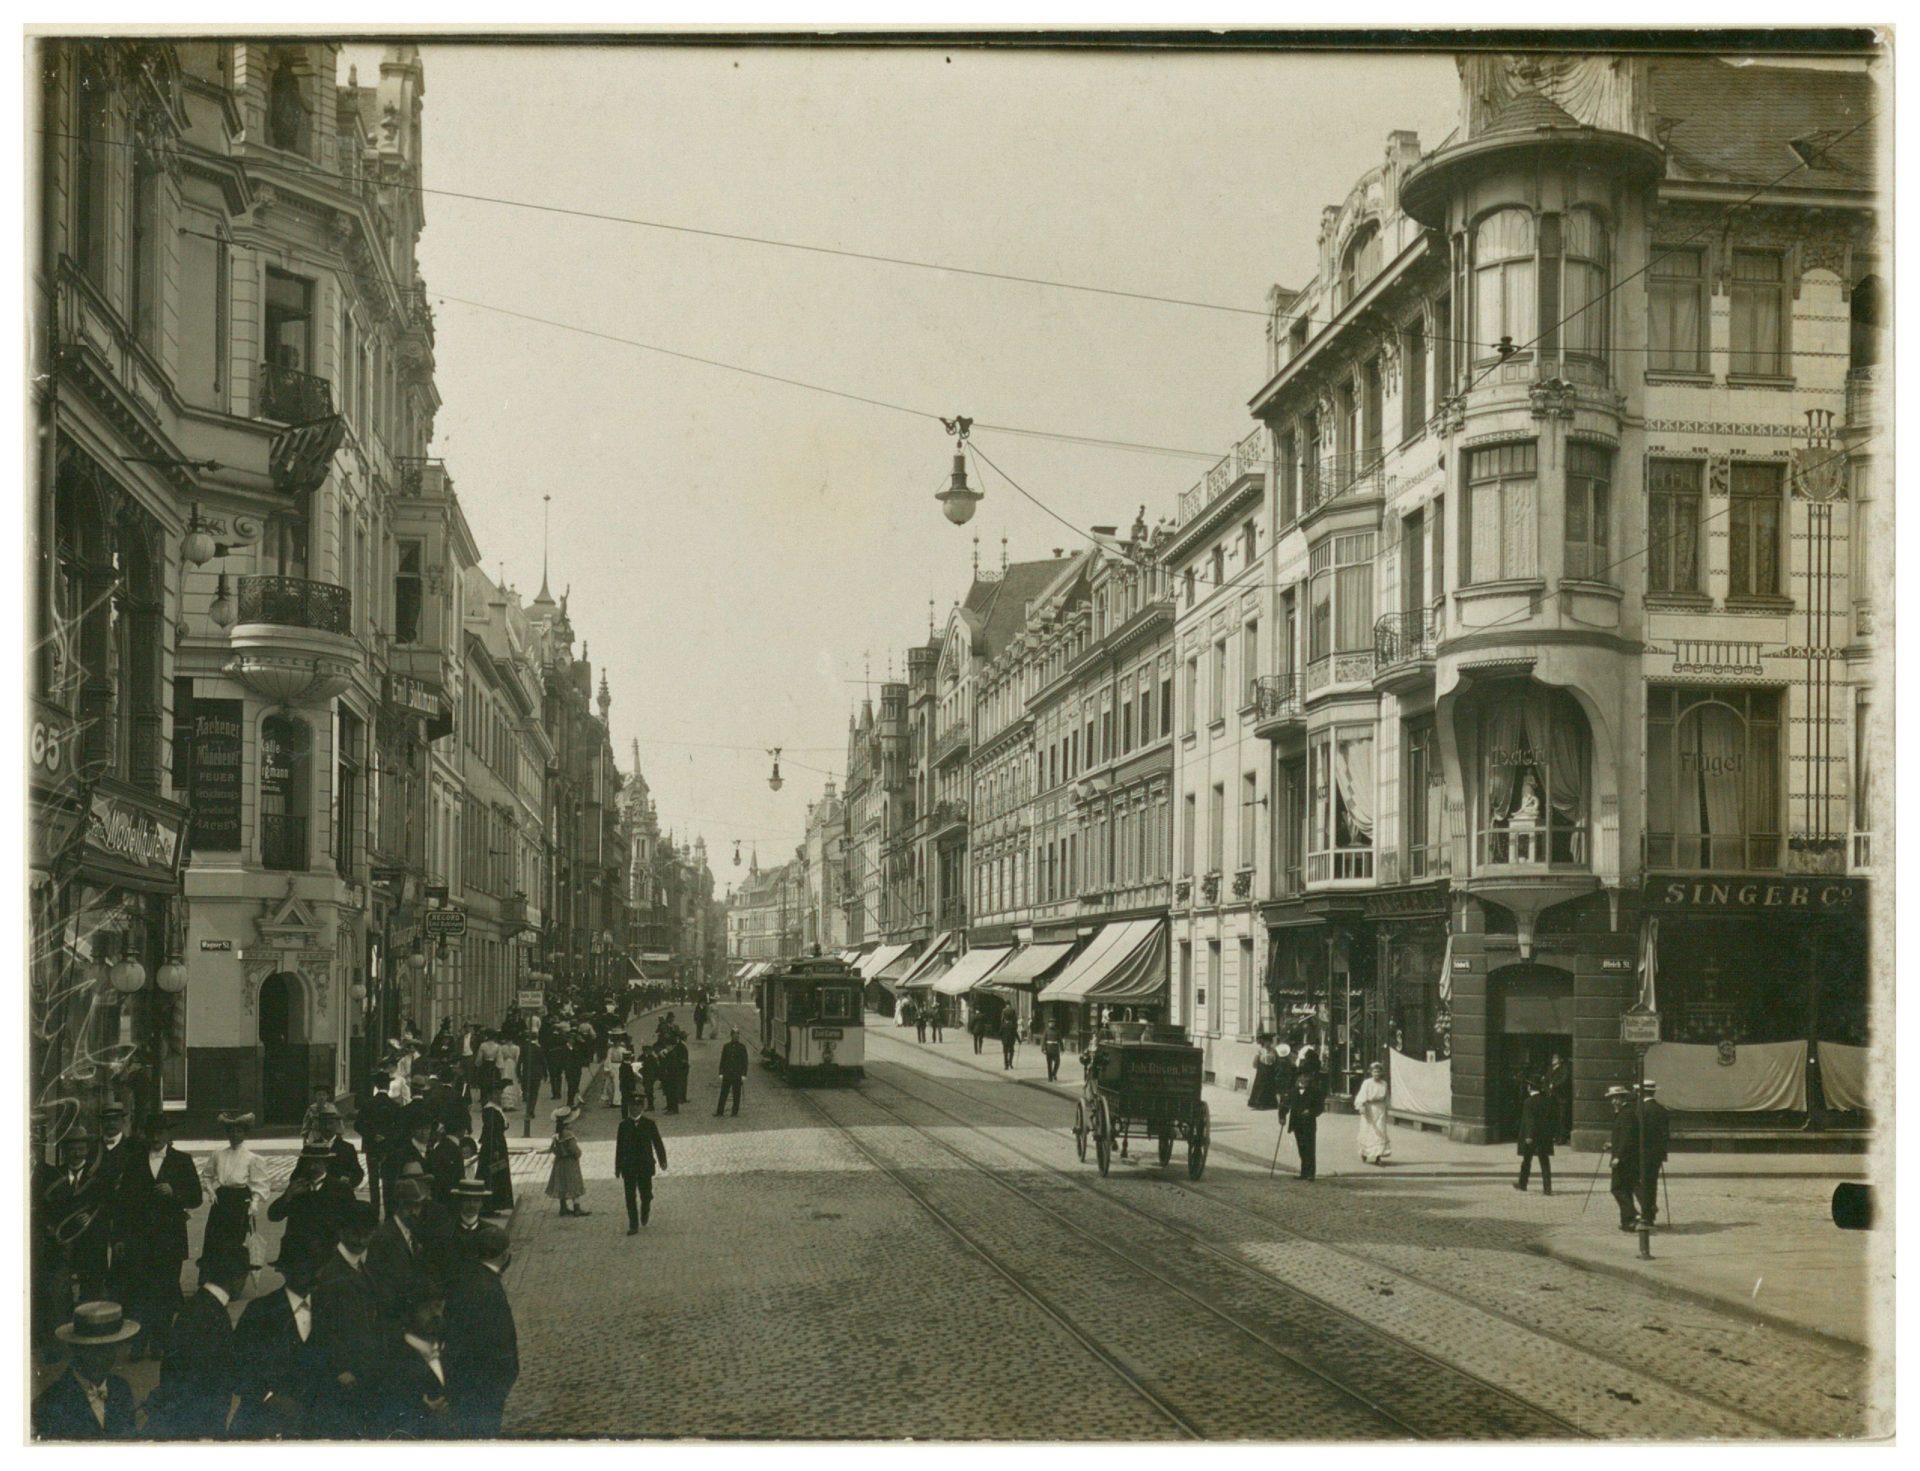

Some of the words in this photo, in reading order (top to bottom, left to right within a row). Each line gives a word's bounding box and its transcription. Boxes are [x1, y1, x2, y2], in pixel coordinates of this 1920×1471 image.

[31, 721, 60, 771] 65
[1681, 752, 1743, 776] Flügel
[199, 772, 235, 782] FEUER
[1664, 883, 1810, 906] SINGER
